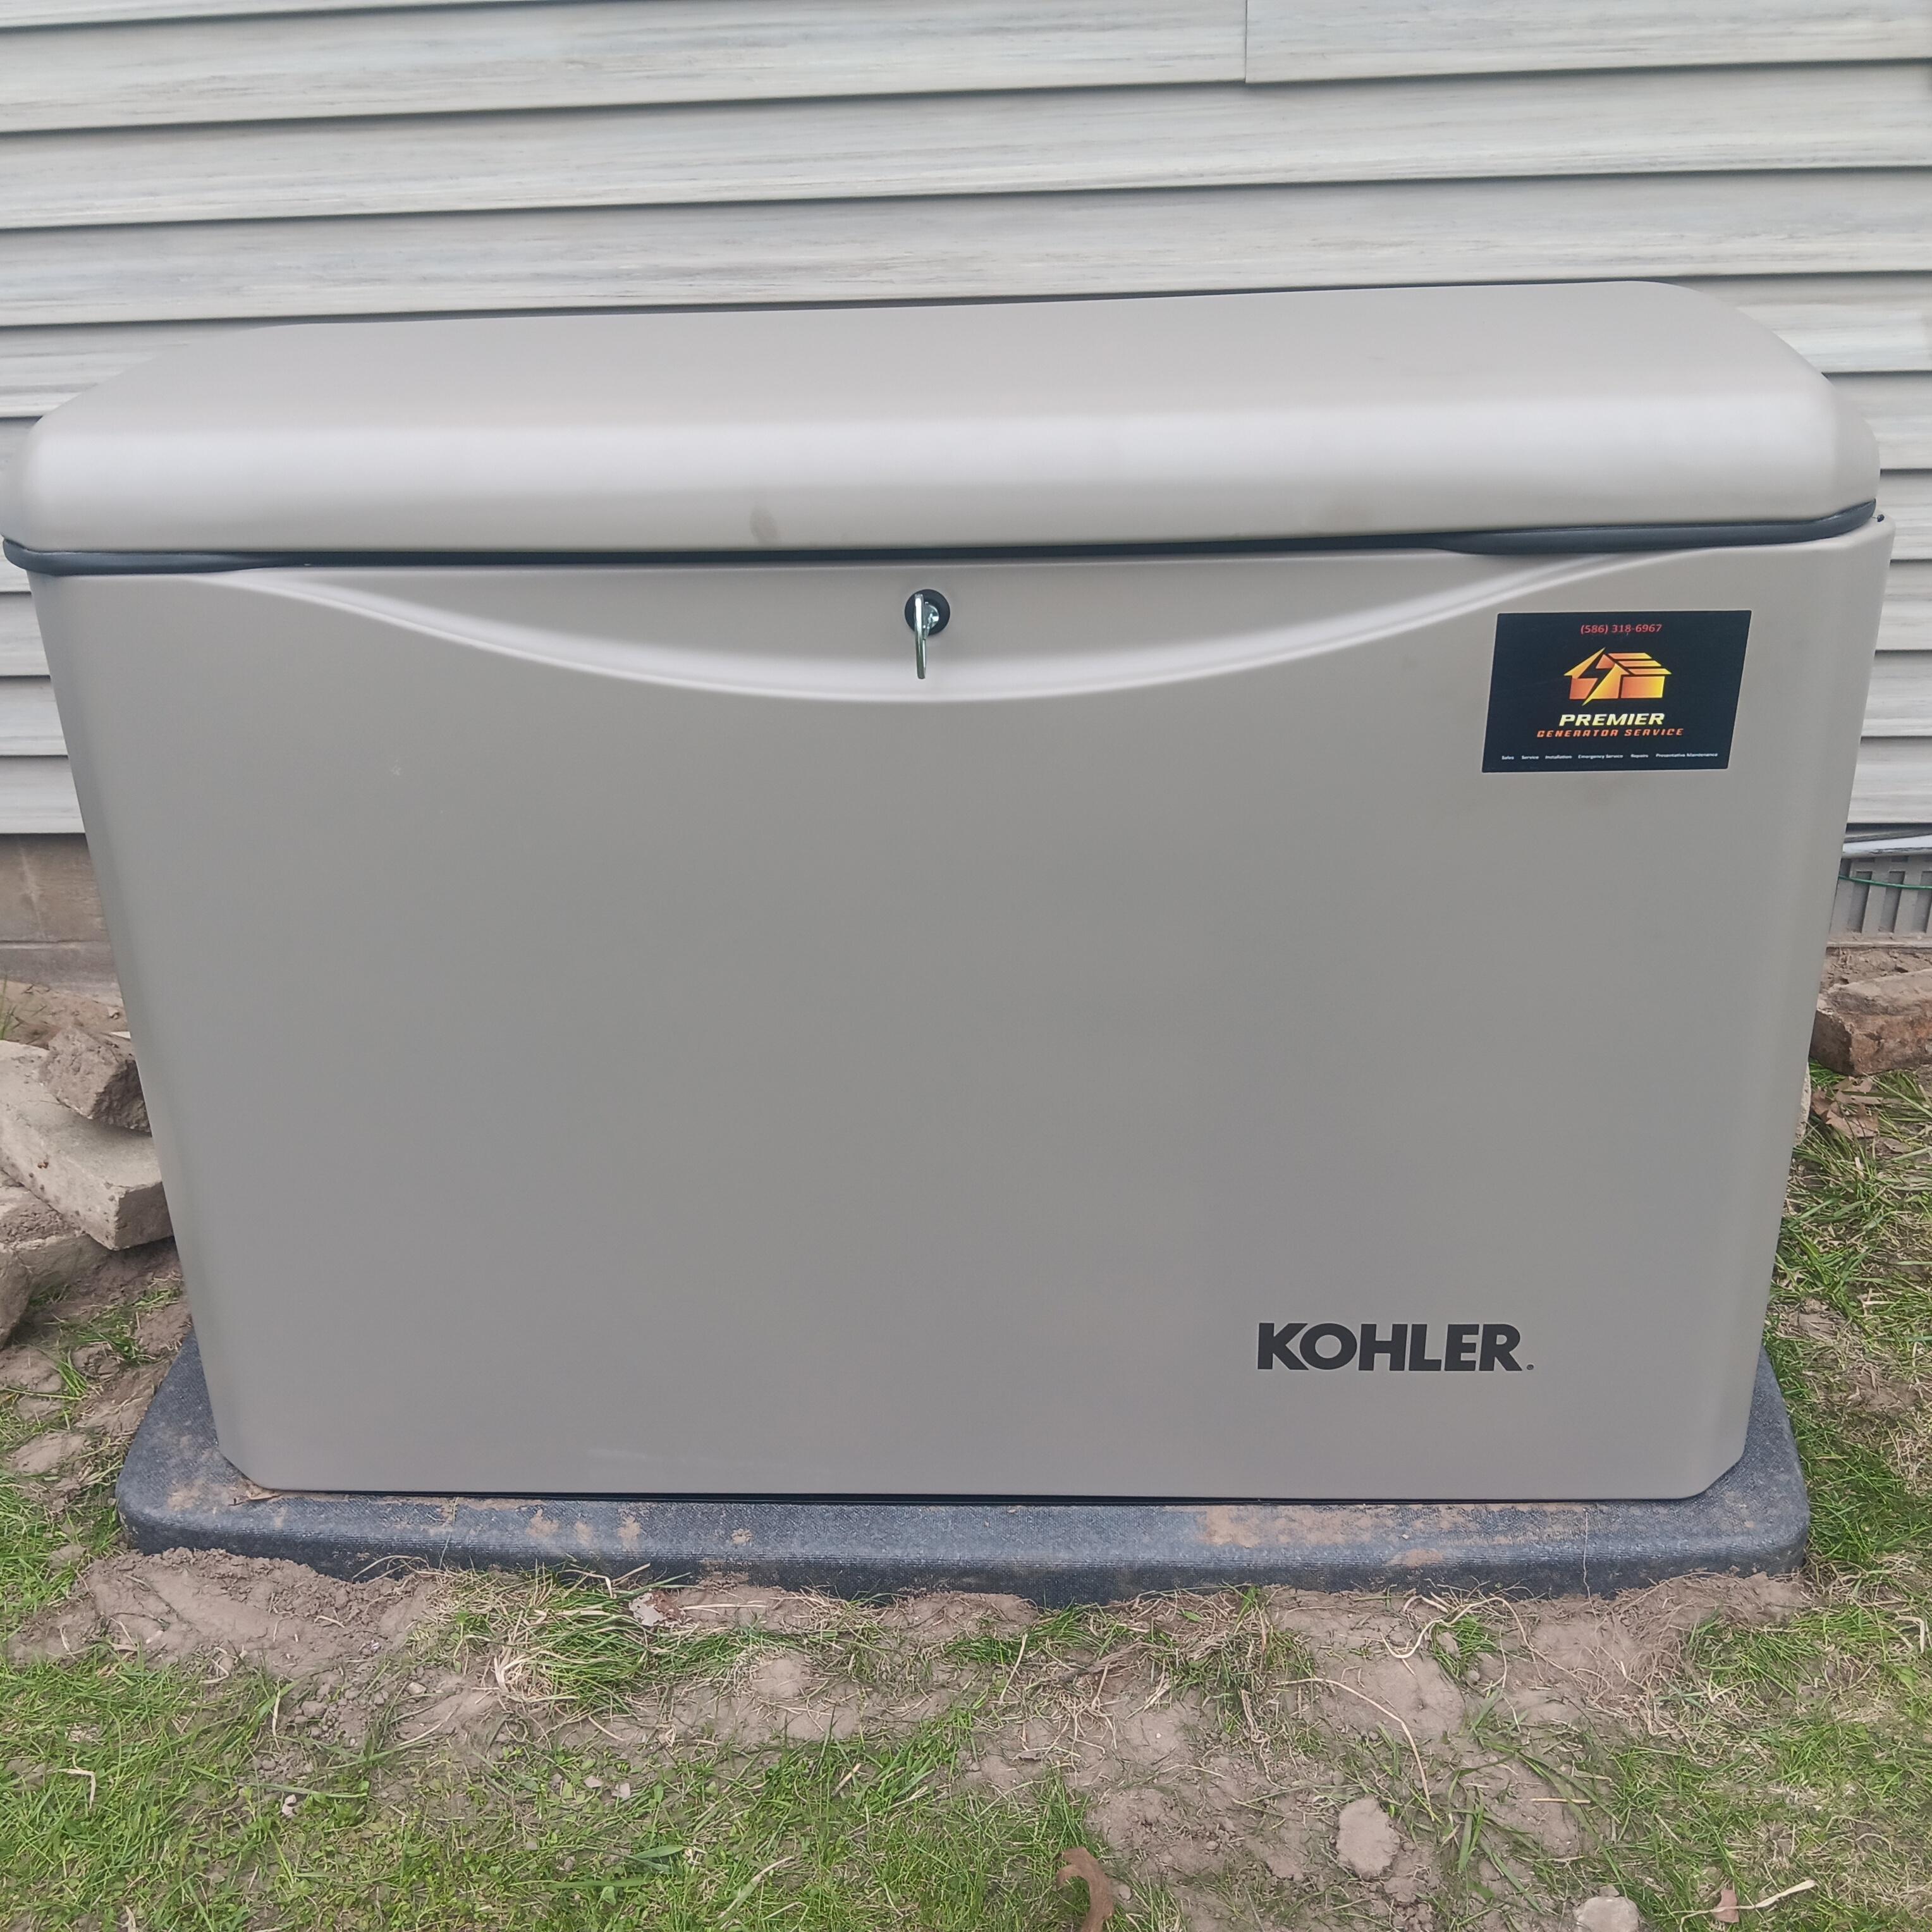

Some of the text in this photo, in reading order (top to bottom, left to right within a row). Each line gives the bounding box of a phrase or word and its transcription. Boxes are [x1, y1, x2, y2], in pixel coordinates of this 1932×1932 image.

[1580, 624, 1662, 634] (586) 318-6967
[1559, 712, 1665, 726] PREMIER
[1536, 728, 1684, 738] GENERATOR SERVICE
[1257, 1323, 1523, 1371] KOHLER
